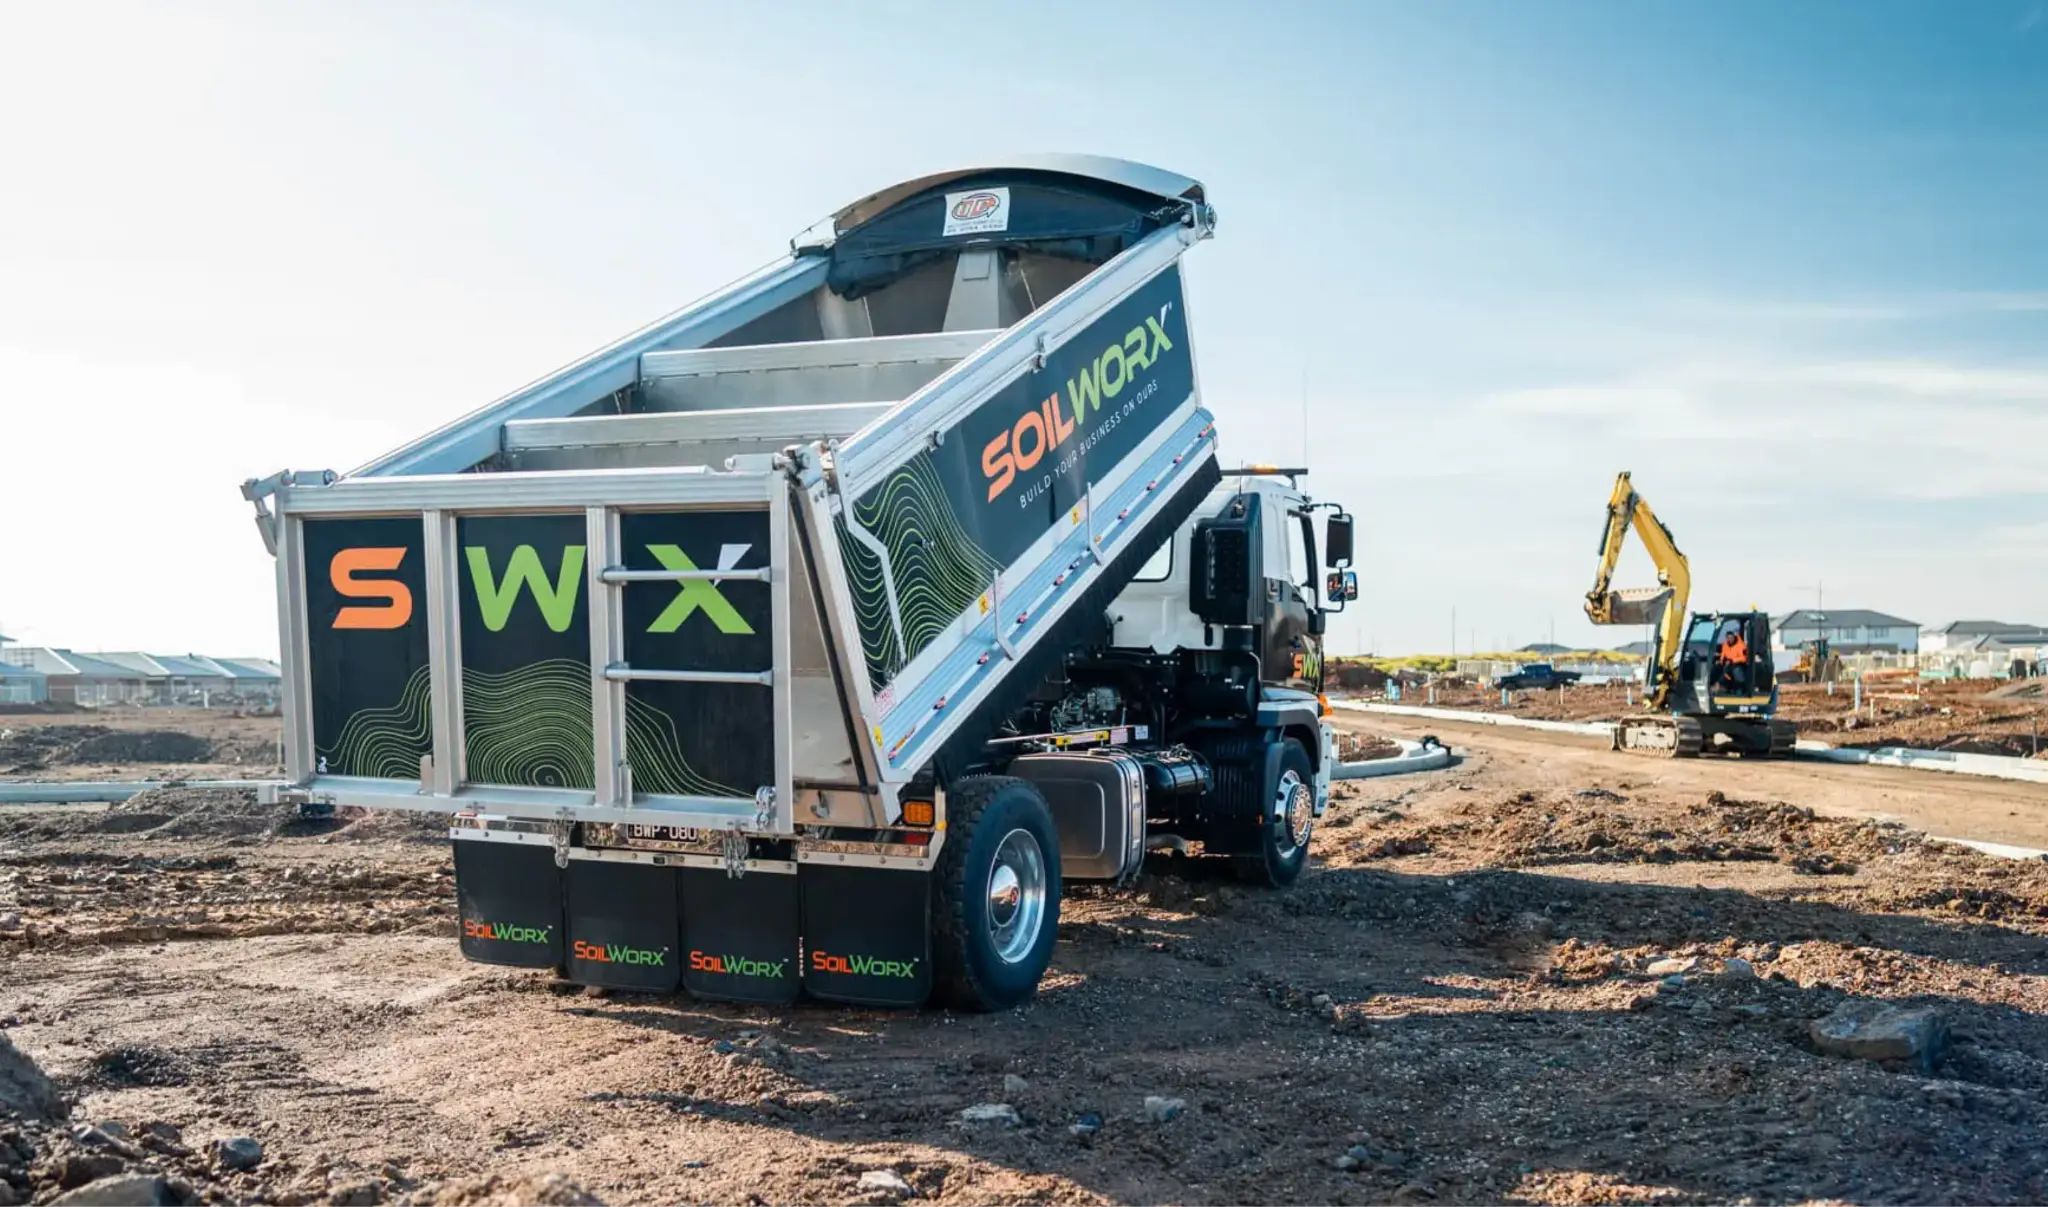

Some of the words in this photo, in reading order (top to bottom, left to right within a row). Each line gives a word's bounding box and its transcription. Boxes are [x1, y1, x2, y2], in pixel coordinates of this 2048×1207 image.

[1019, 475, 1051, 509] BUILD
[1054, 450, 1078, 479] YOUR
[1080, 412, 1121, 455] BUSINESS
[1122, 399, 1136, 417] ON
[1137, 379, 1159, 405] OURS
[1292, 652, 1320, 679] SWX
